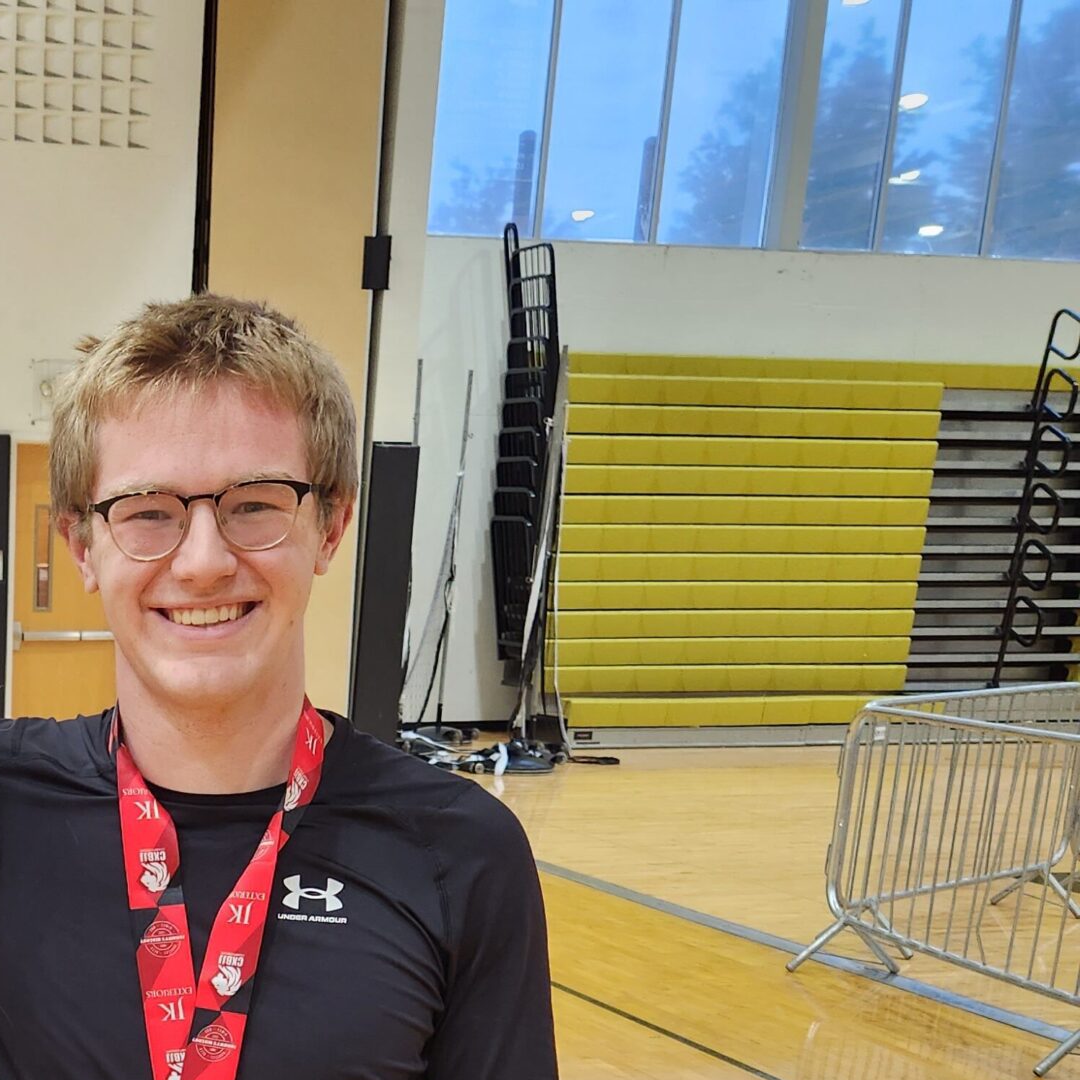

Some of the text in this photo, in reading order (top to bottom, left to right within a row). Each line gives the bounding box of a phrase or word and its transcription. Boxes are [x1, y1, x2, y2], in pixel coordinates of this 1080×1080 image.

[228, 901, 253, 924] JK
[277, 913, 348, 924] UNDER ARMOUR
[218, 954, 244, 967] CXBJJ
[145, 986, 192, 998] EXTERIORS
[157, 996, 185, 1021] JK
